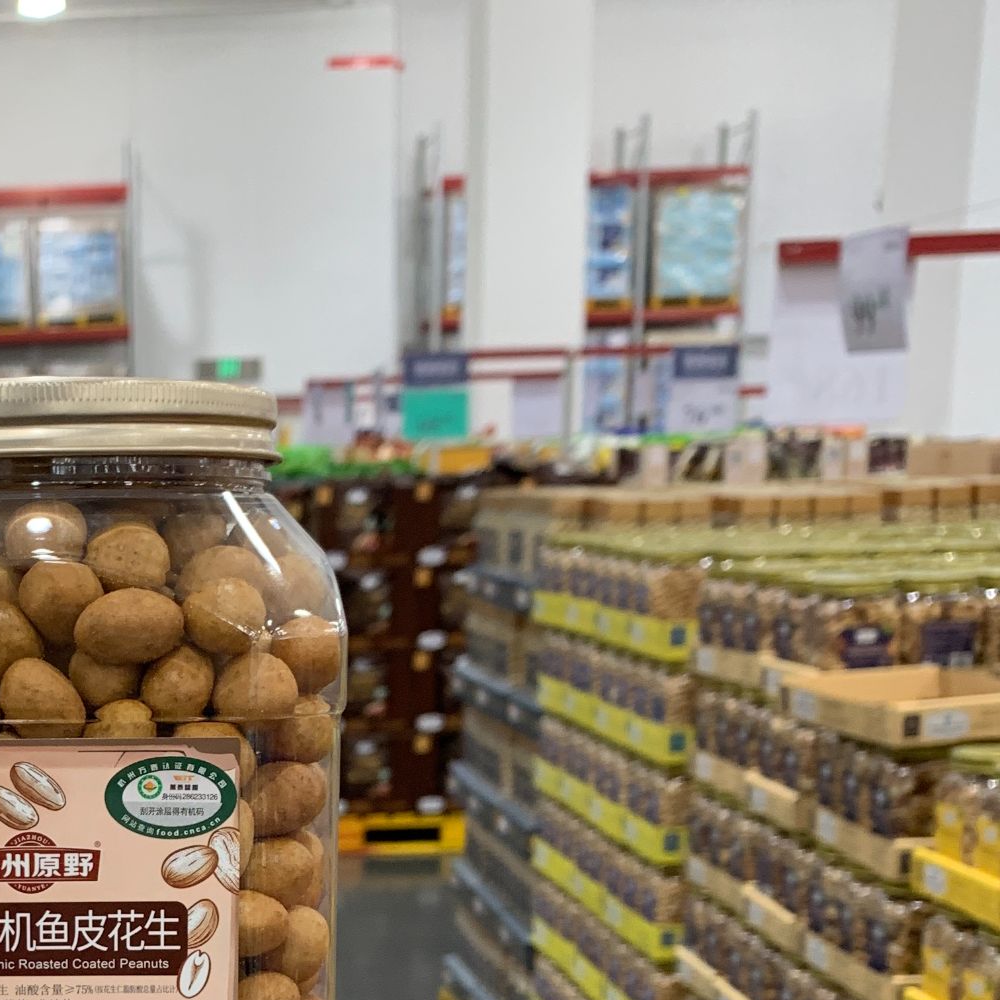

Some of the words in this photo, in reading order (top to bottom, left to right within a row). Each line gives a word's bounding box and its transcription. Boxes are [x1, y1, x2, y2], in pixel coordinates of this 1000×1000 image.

[18, 959, 68, 970] Roasted
[72, 958, 116, 969] Coated
[120, 958, 169, 969] Peanuts
